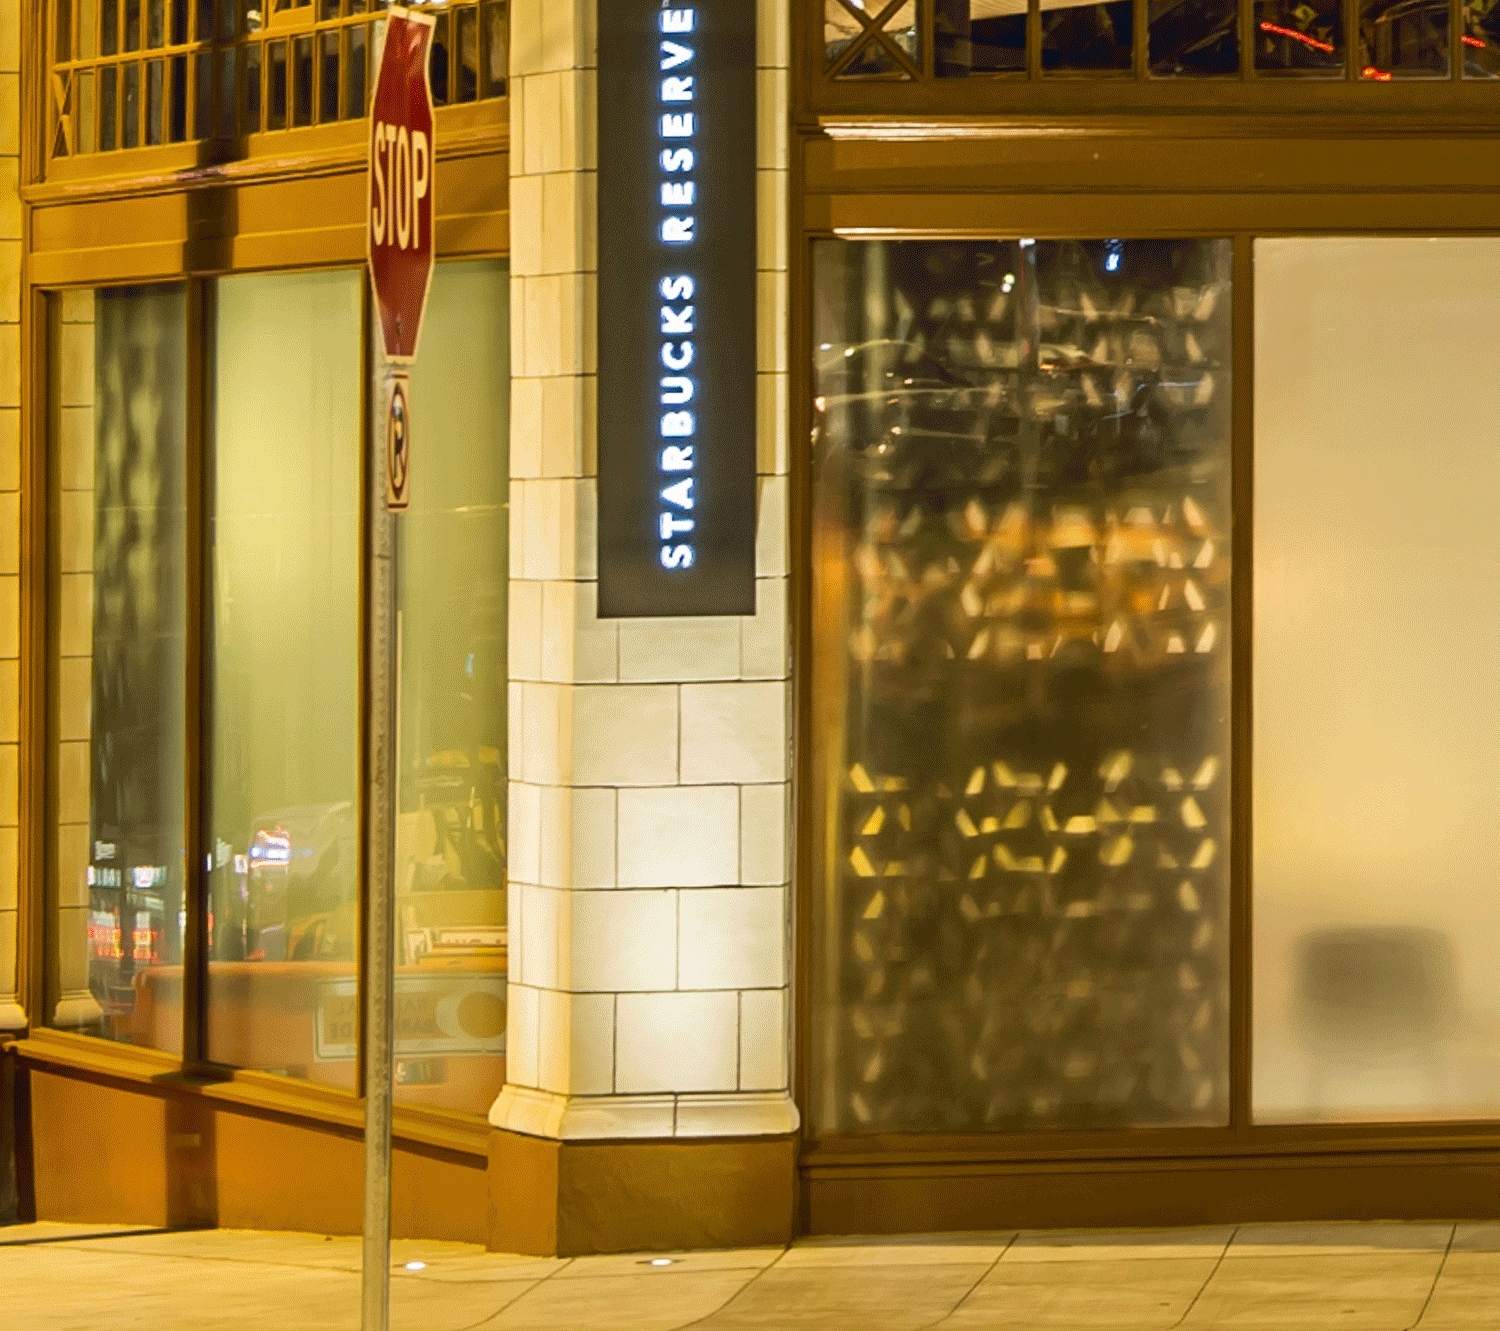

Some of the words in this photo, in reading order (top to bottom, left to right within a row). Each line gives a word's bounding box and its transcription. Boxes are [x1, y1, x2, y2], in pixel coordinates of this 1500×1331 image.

[372, 119, 429, 251] STOP
[660, 8, 696, 242] RESERVE
[659, 274, 696, 570] STARBUCKS
